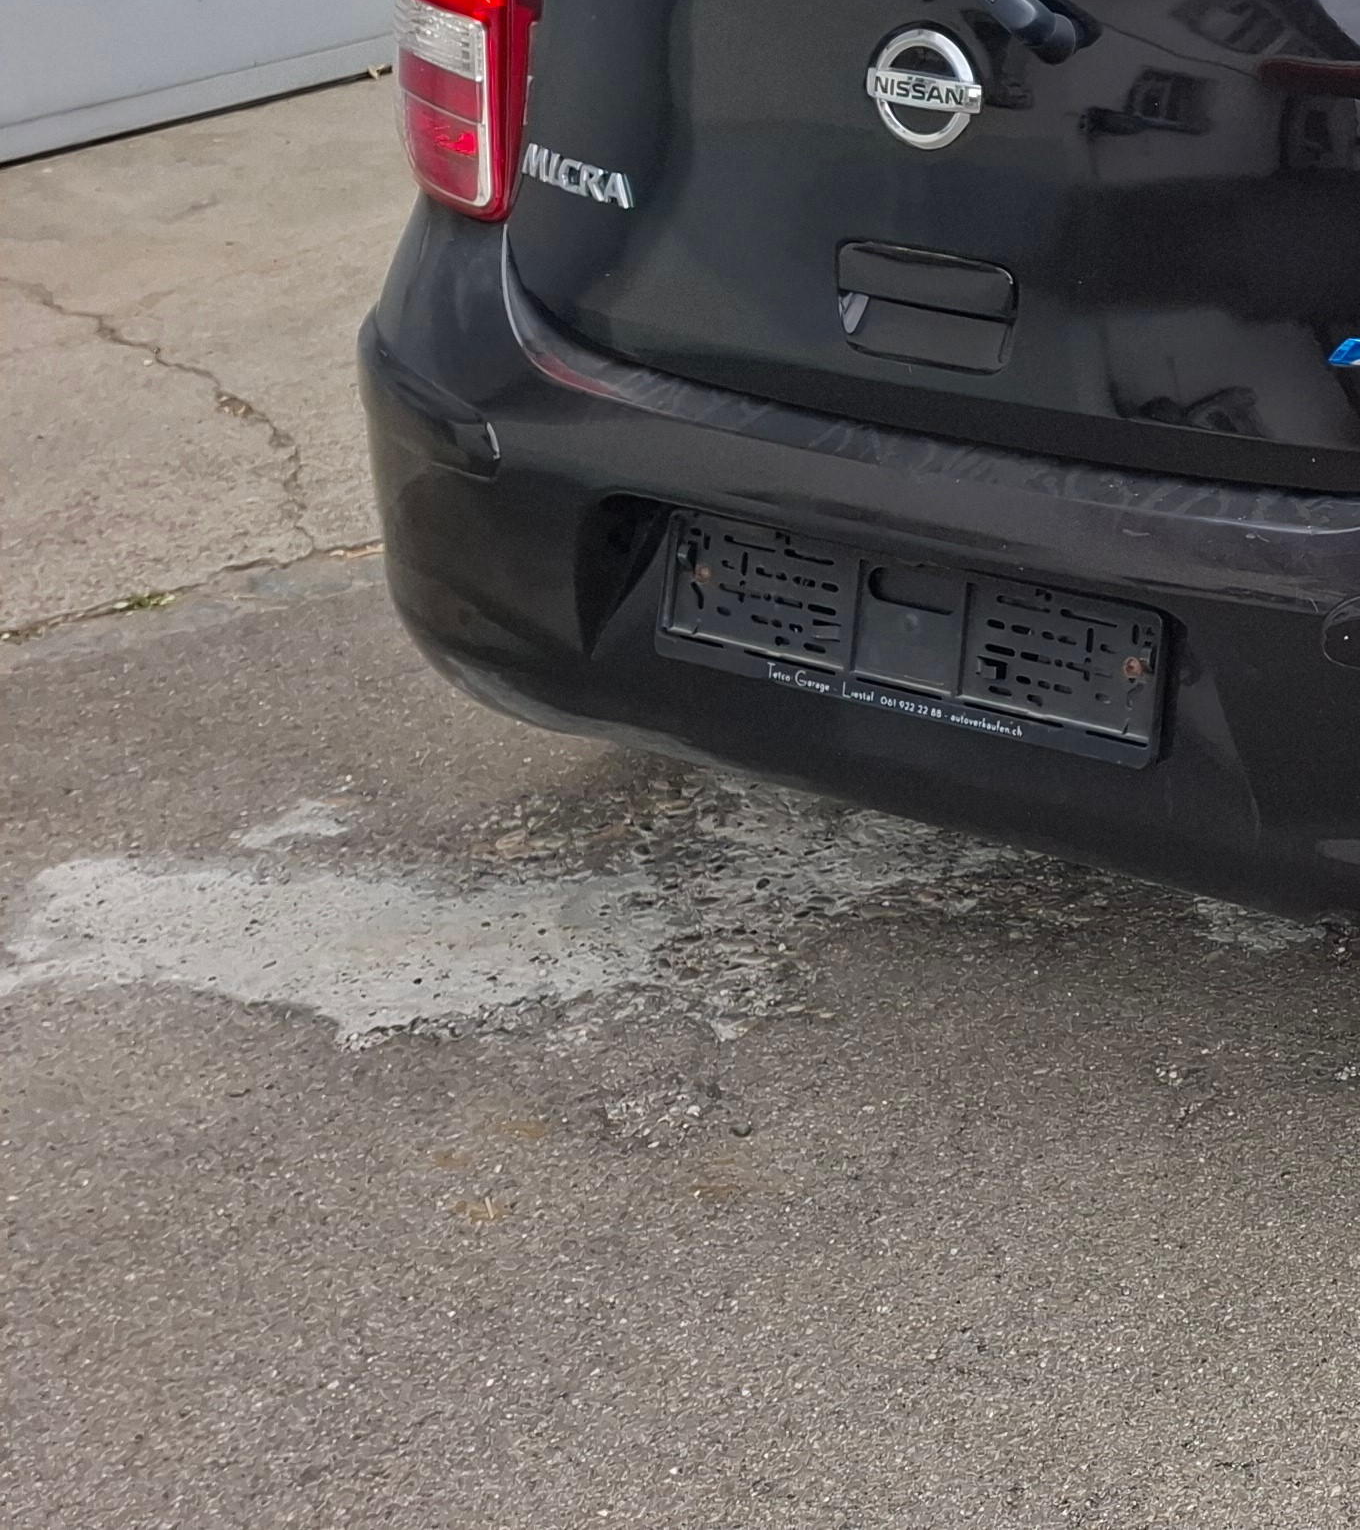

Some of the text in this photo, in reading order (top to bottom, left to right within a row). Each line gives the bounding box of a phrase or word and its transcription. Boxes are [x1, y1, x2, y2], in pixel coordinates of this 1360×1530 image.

[874, 76, 964, 106] NISSAN
[521, 143, 634, 209] MICRA
[794, 669, 830, 693] Garage
